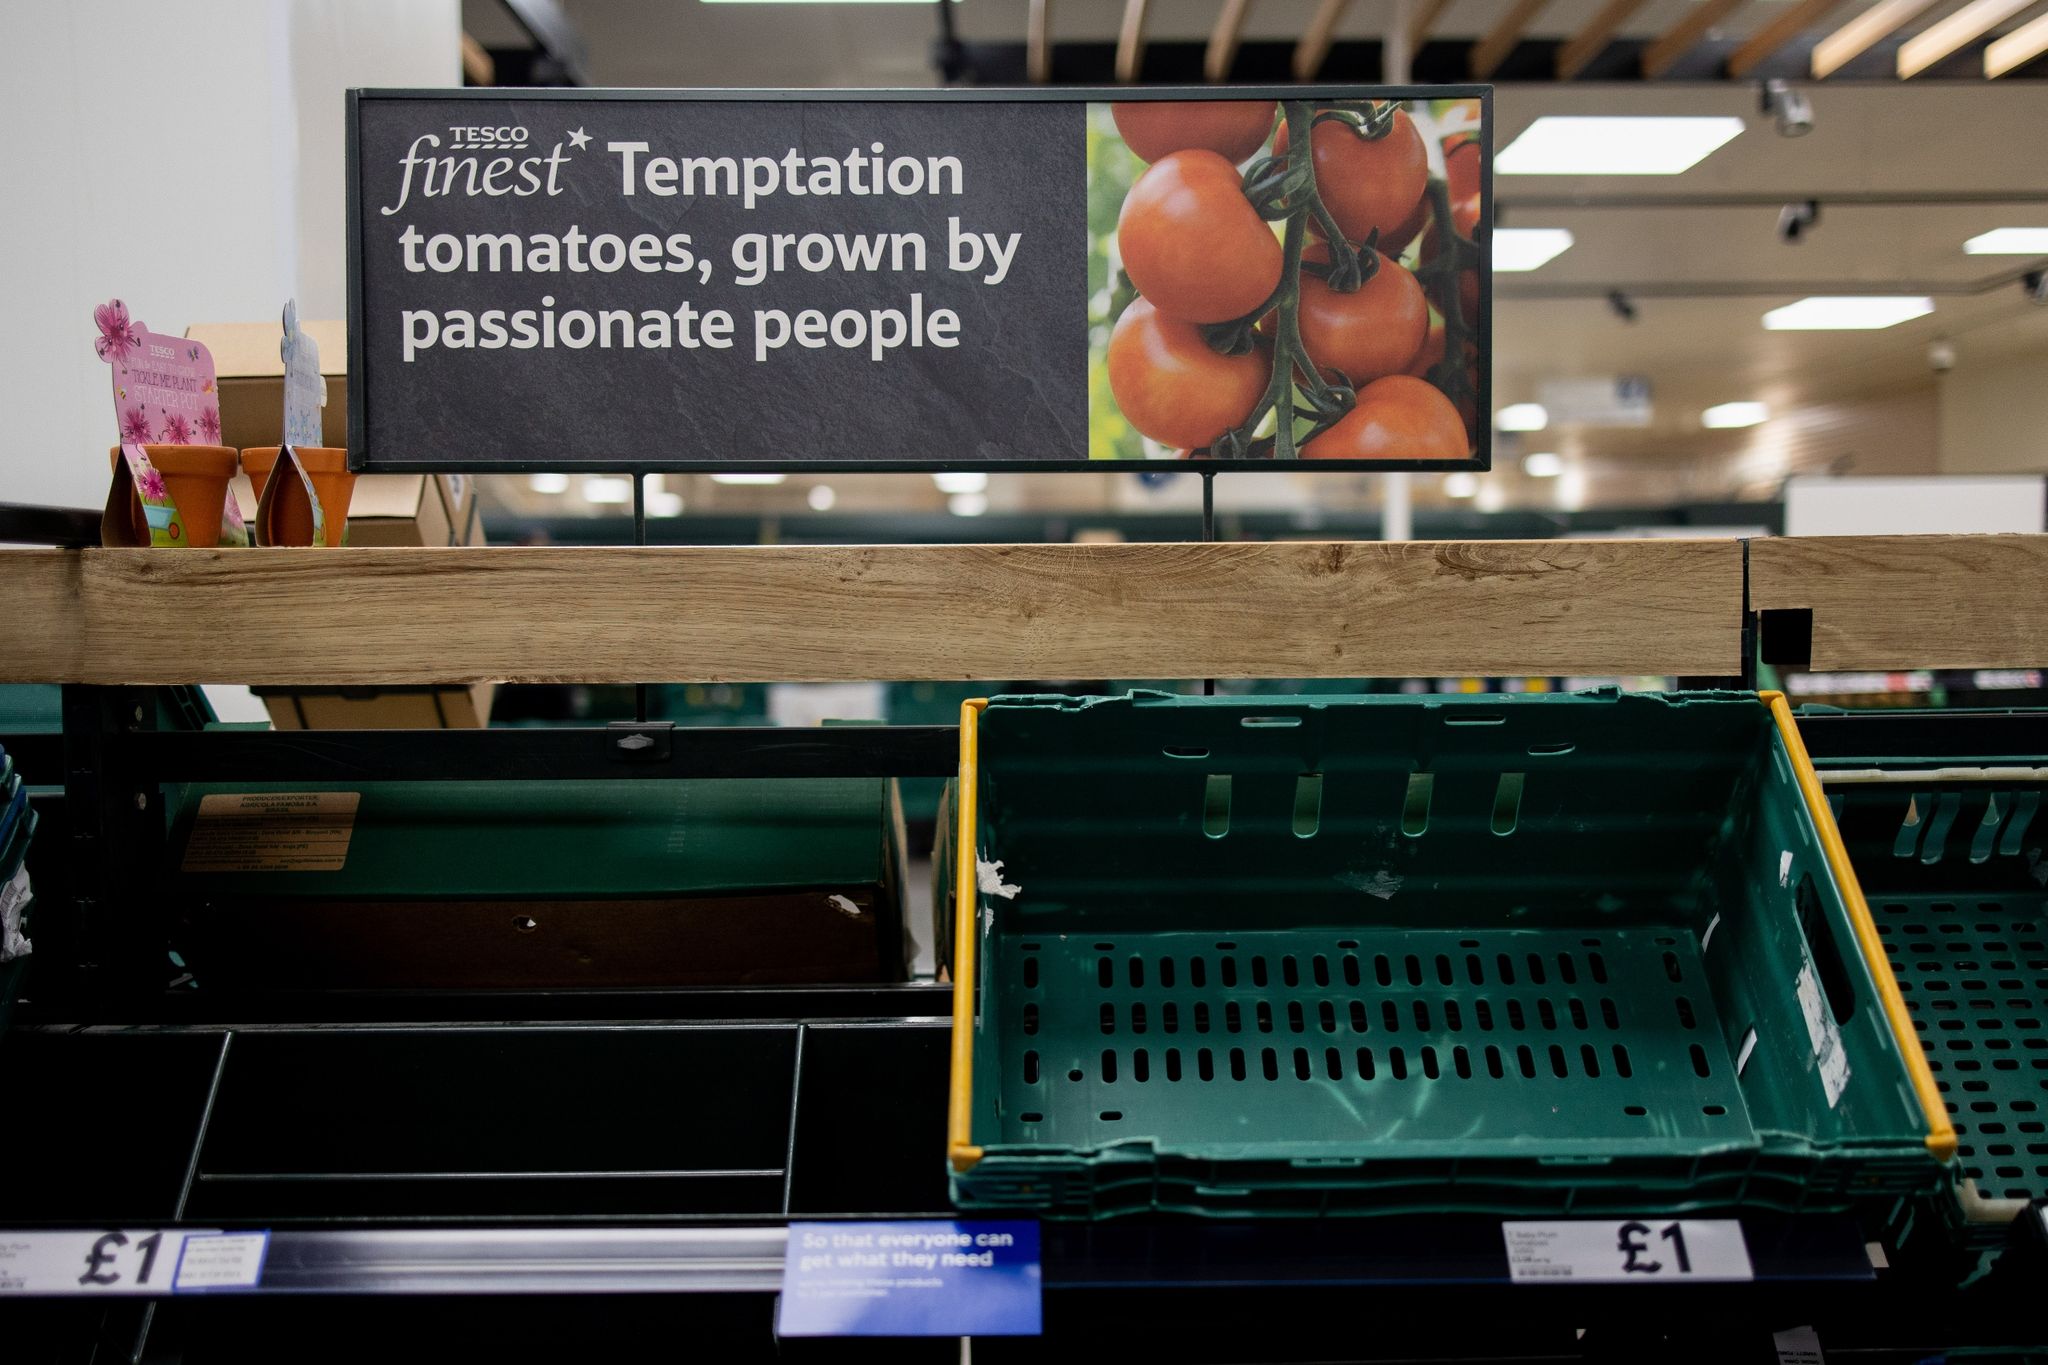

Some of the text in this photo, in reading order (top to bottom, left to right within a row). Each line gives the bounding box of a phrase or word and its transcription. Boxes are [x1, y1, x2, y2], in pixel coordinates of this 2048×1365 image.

[450, 127, 529, 143] TESCO
[380, 133, 964, 215] finest Temptation
[399, 217, 1022, 286] tomatoes, grown by
[402, 293, 961, 362] passionate people
[149, 344, 175, 356] TESCO
[173, 375, 198, 394] PLANT
[134, 385, 179, 410] STARTER
[803, 1232, 1014, 1251] So that everyone can
[1617, 1220, 1692, 1274] £1
[78, 1231, 163, 1286] £1
[800, 1250, 994, 1271] get what they need
